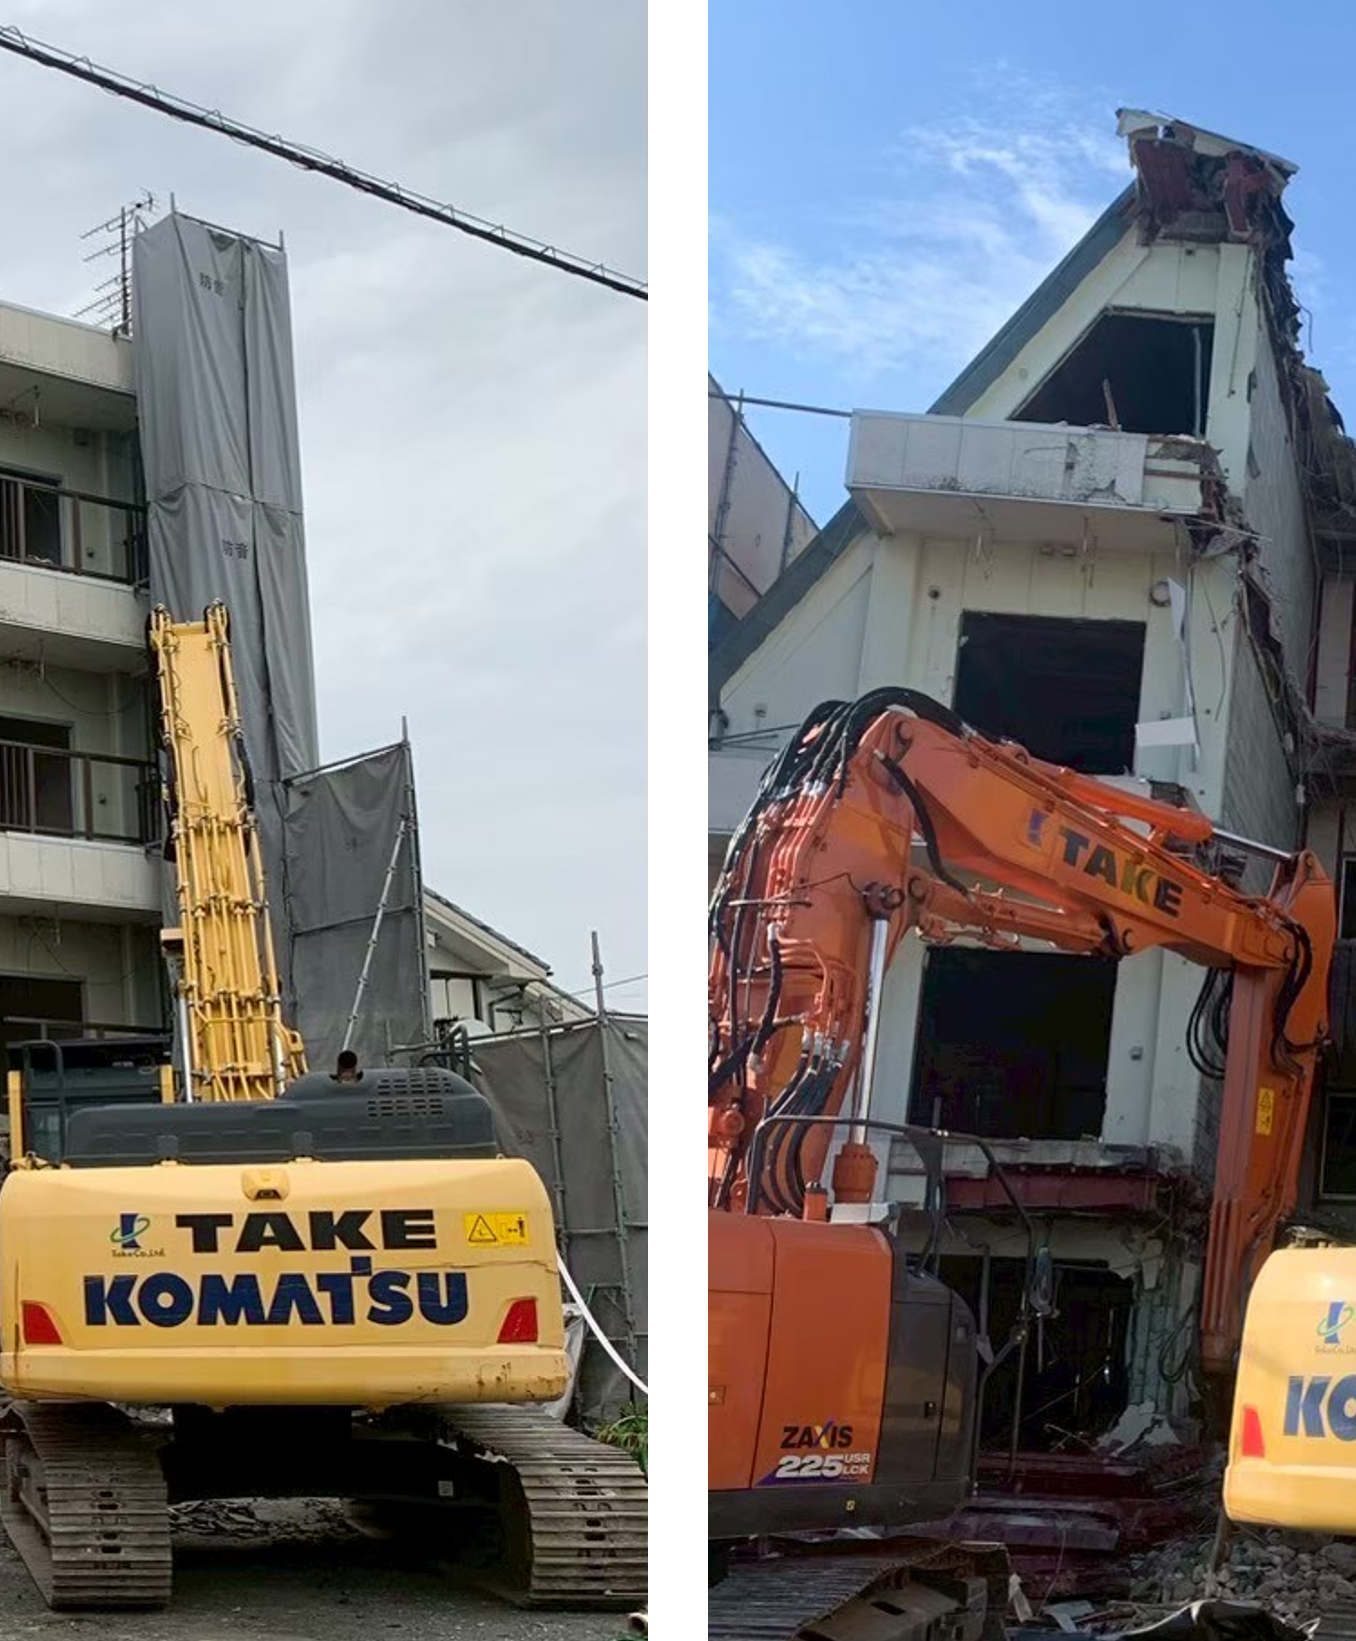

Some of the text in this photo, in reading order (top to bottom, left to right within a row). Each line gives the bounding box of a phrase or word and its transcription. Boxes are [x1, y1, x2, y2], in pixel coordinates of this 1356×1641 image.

[1060, 825, 1183, 919] TAKE
[175, 1209, 437, 1253] TAKE
[83, 1256, 469, 1328] KOMATSU
[780, 1419, 853, 1449] ZAXIS
[775, 1453, 871, 1478] 225 USR
